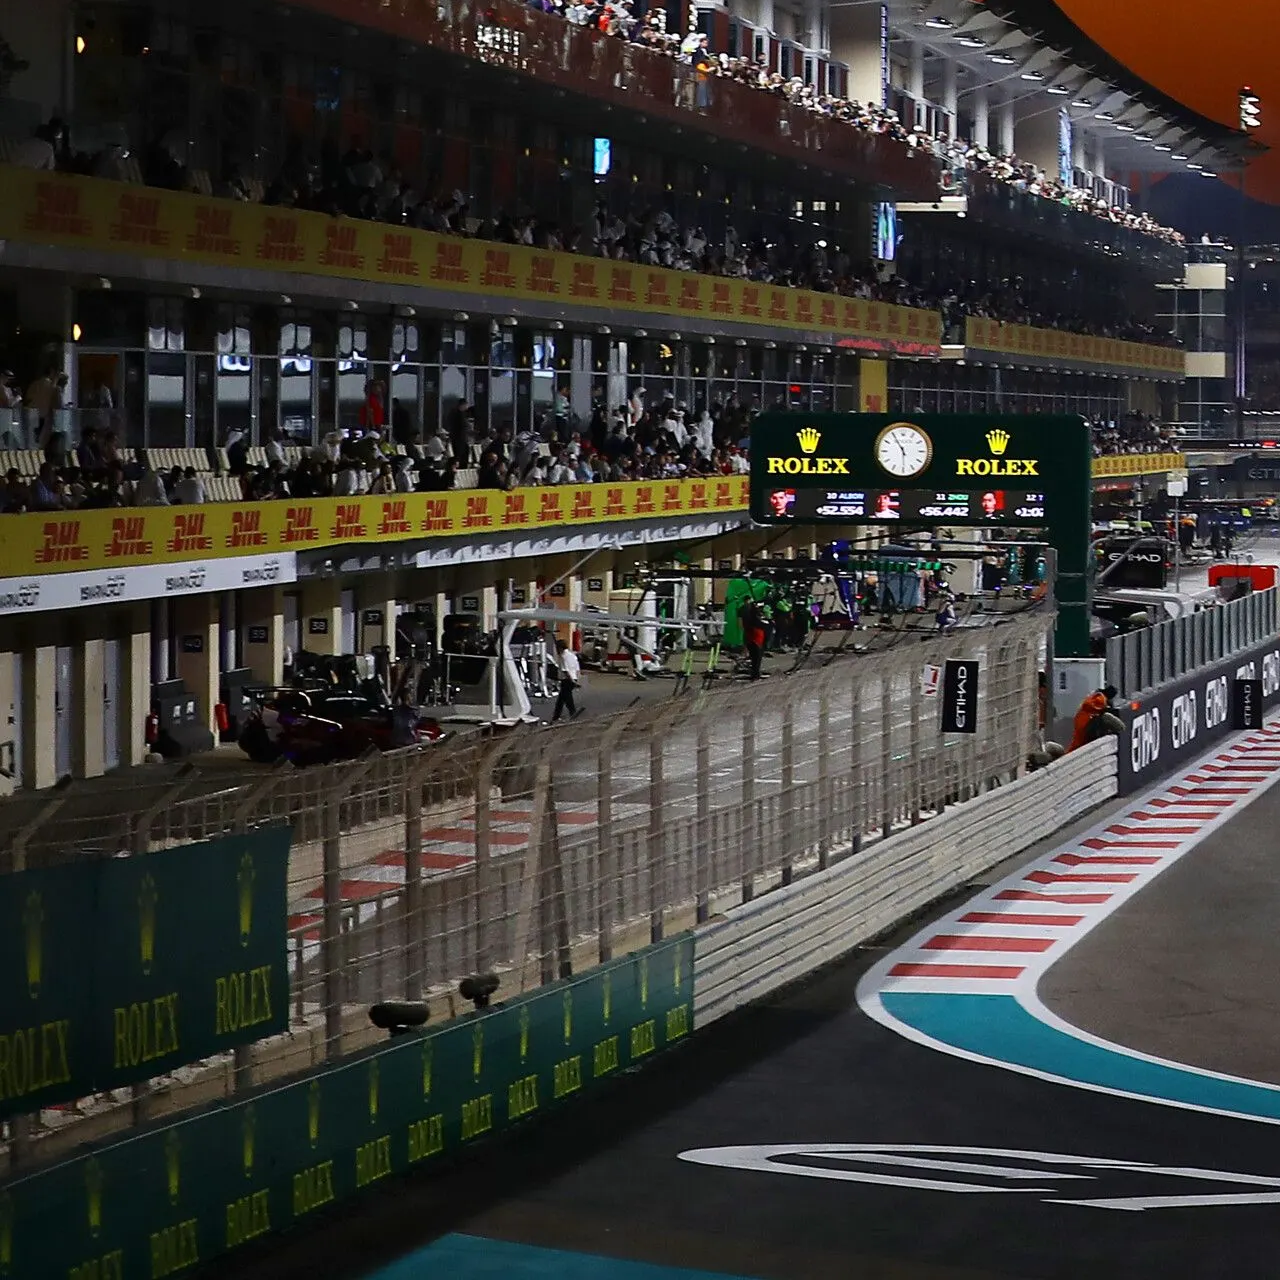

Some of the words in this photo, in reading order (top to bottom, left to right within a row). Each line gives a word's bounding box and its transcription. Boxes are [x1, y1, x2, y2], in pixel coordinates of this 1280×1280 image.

[767, 457, 850, 474] ROLEX
[956, 459, 1039, 476] ROLEX
[229, 511, 264, 547] DHL
[283, 508, 316, 542] DHL
[334, 505, 364, 538] DHL
[381, 502, 408, 534] DHL
[424, 500, 450, 530] DHL
[464, 498, 490, 527] DHL
[919, 506, 969, 517] +56.442
[39, 522, 85, 563] DHL
[107, 518, 150, 556] DHL
[169, 514, 209, 552] DHL
[1108, 552, 1161, 563] ETIHAD
[956, 666, 968, 728] ETIHAD
[1243, 684, 1251, 726] ETIHAD
[1172, 690, 1197, 749] ETIHAD
[1131, 707, 1160, 773] ETIHAD
[215, 964, 273, 1036] ROLEX
[114, 992, 180, 1070] ROLEX
[0, 1019, 72, 1101] ROLEX
